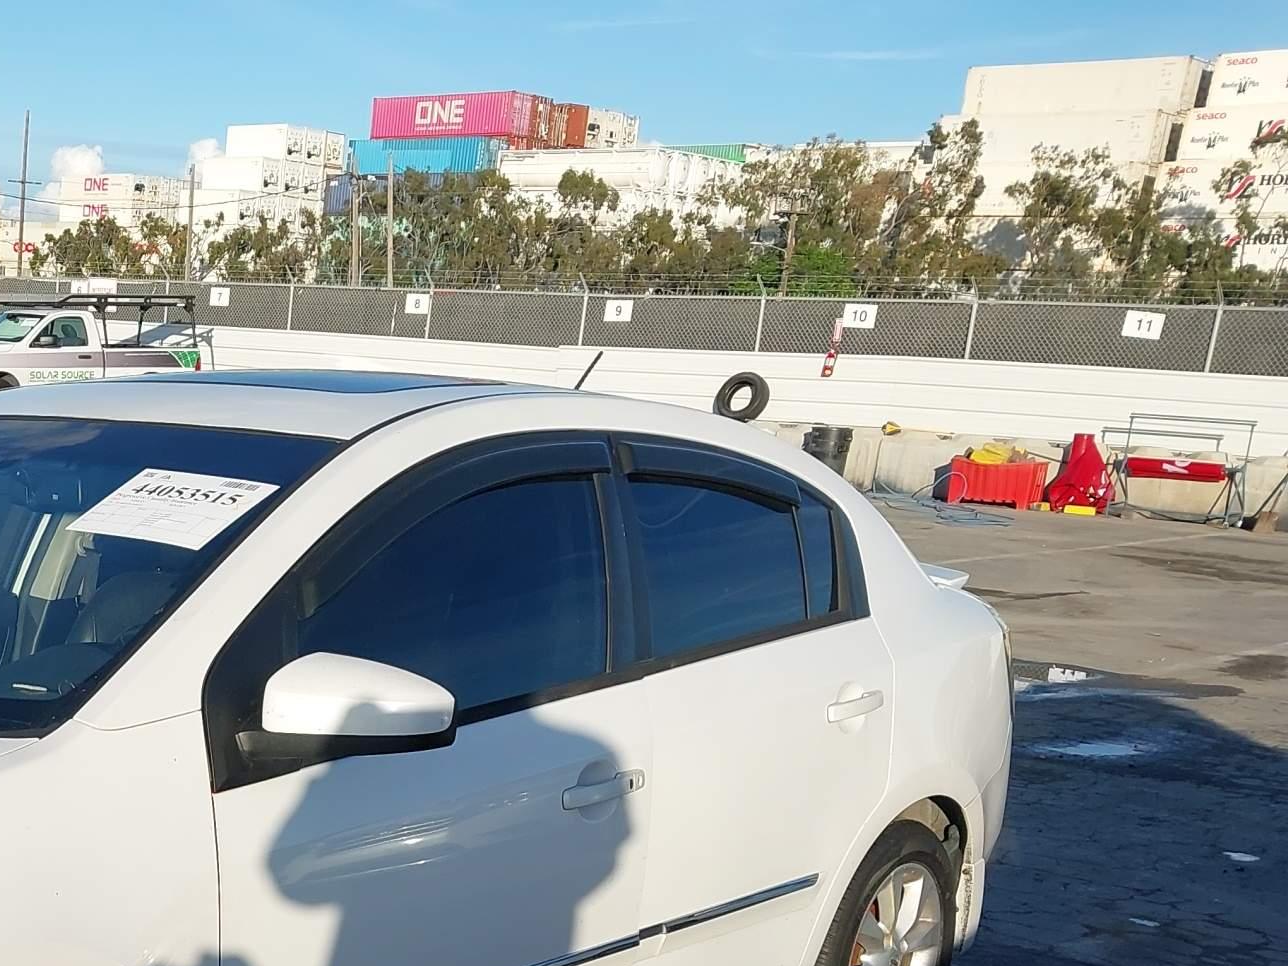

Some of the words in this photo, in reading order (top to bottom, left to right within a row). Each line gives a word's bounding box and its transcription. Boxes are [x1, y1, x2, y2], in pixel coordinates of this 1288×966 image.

[1226, 57, 1258, 66] seaco
[415, 99, 465, 125] ONE
[1196, 112, 1227, 120] seaco
[84, 177, 109, 191] ONE
[1259, 174, 1288, 186] HO
[217, 292, 223, 302] 7
[414, 298, 421, 309] 8
[615, 305, 622, 316] 9
[852, 309, 868, 322] 10
[1137, 318, 1153, 332] 11
[29, 370, 59, 380] SOLAR
[61, 370, 95, 380] SOURCE
[131, 482, 245, 507] 44053515
